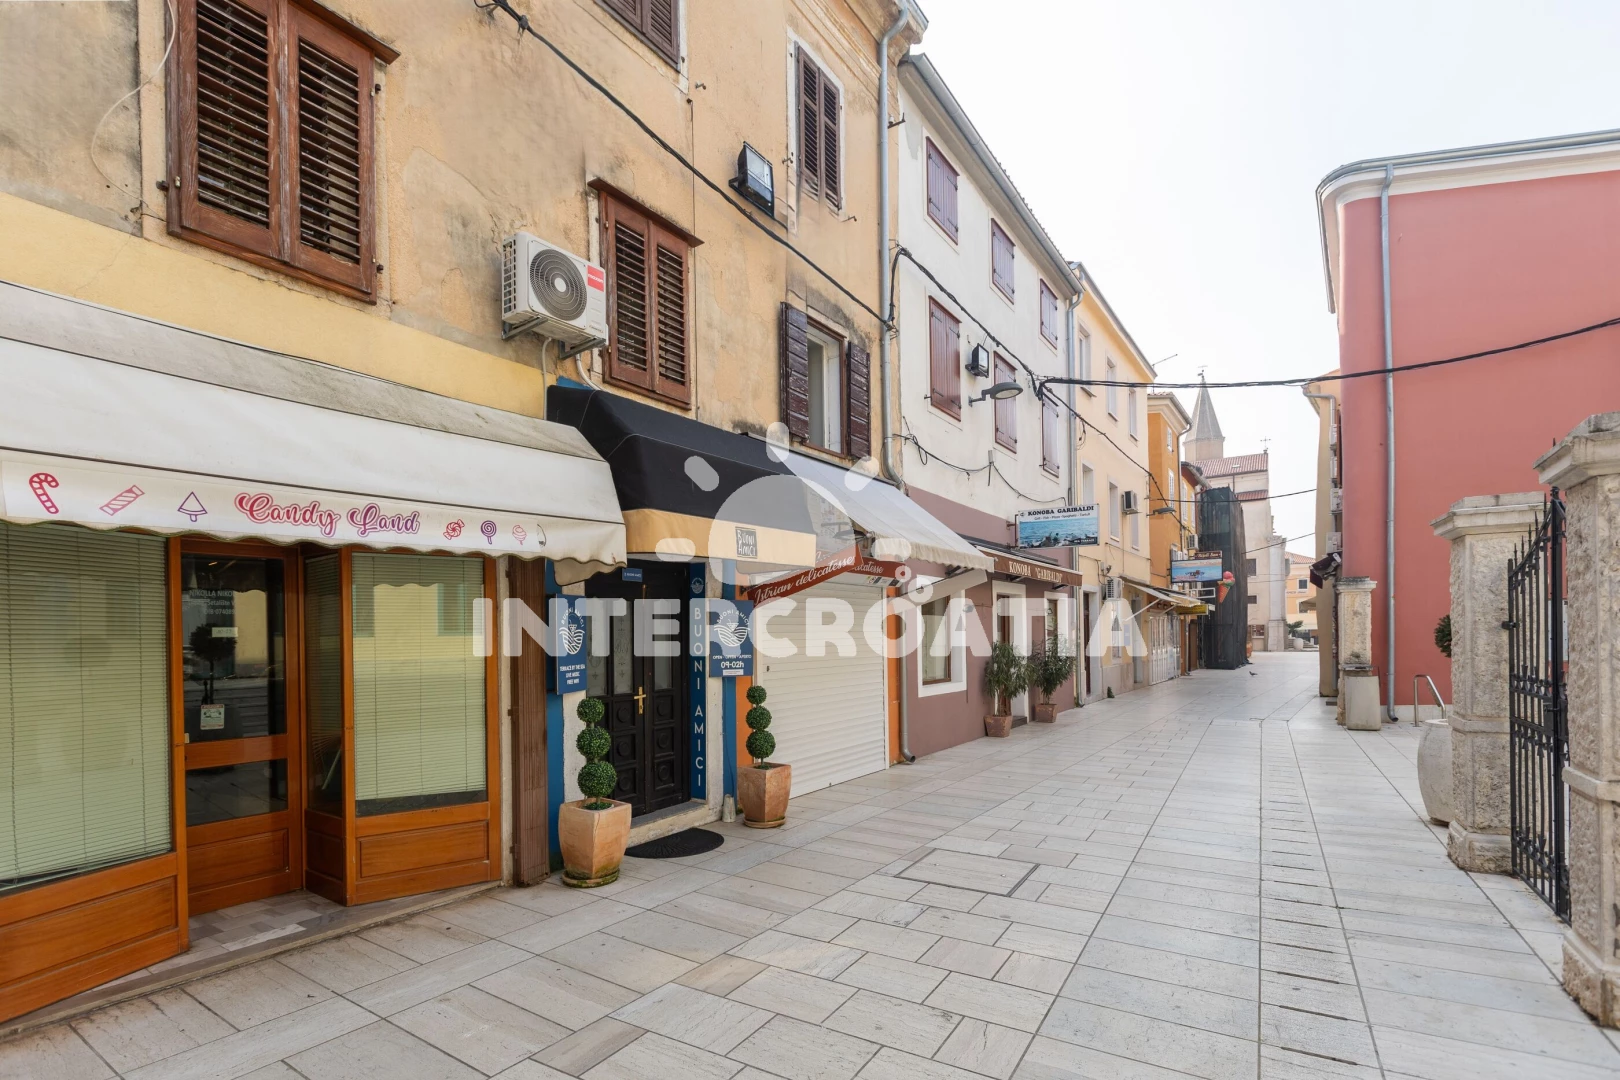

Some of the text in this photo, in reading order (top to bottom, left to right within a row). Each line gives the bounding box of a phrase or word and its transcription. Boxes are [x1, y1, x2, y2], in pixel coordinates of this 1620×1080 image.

[235, 493, 420, 537] Candy Land
[1057, 506, 1094, 514] GARIBALDI
[736, 530, 754, 546] BUONI
[738, 540, 756, 556] AMICI
[1008, 561, 1032, 576] KONOBA
[754, 580, 795, 604] Istrian
[795, 556, 855, 586] delicatesse
[717, 609, 750, 625] BUONI AMICI
[694, 608, 703, 690] BUONI
[721, 660, 744, 668] 09-02h
[694, 705, 704, 786] AMICI
